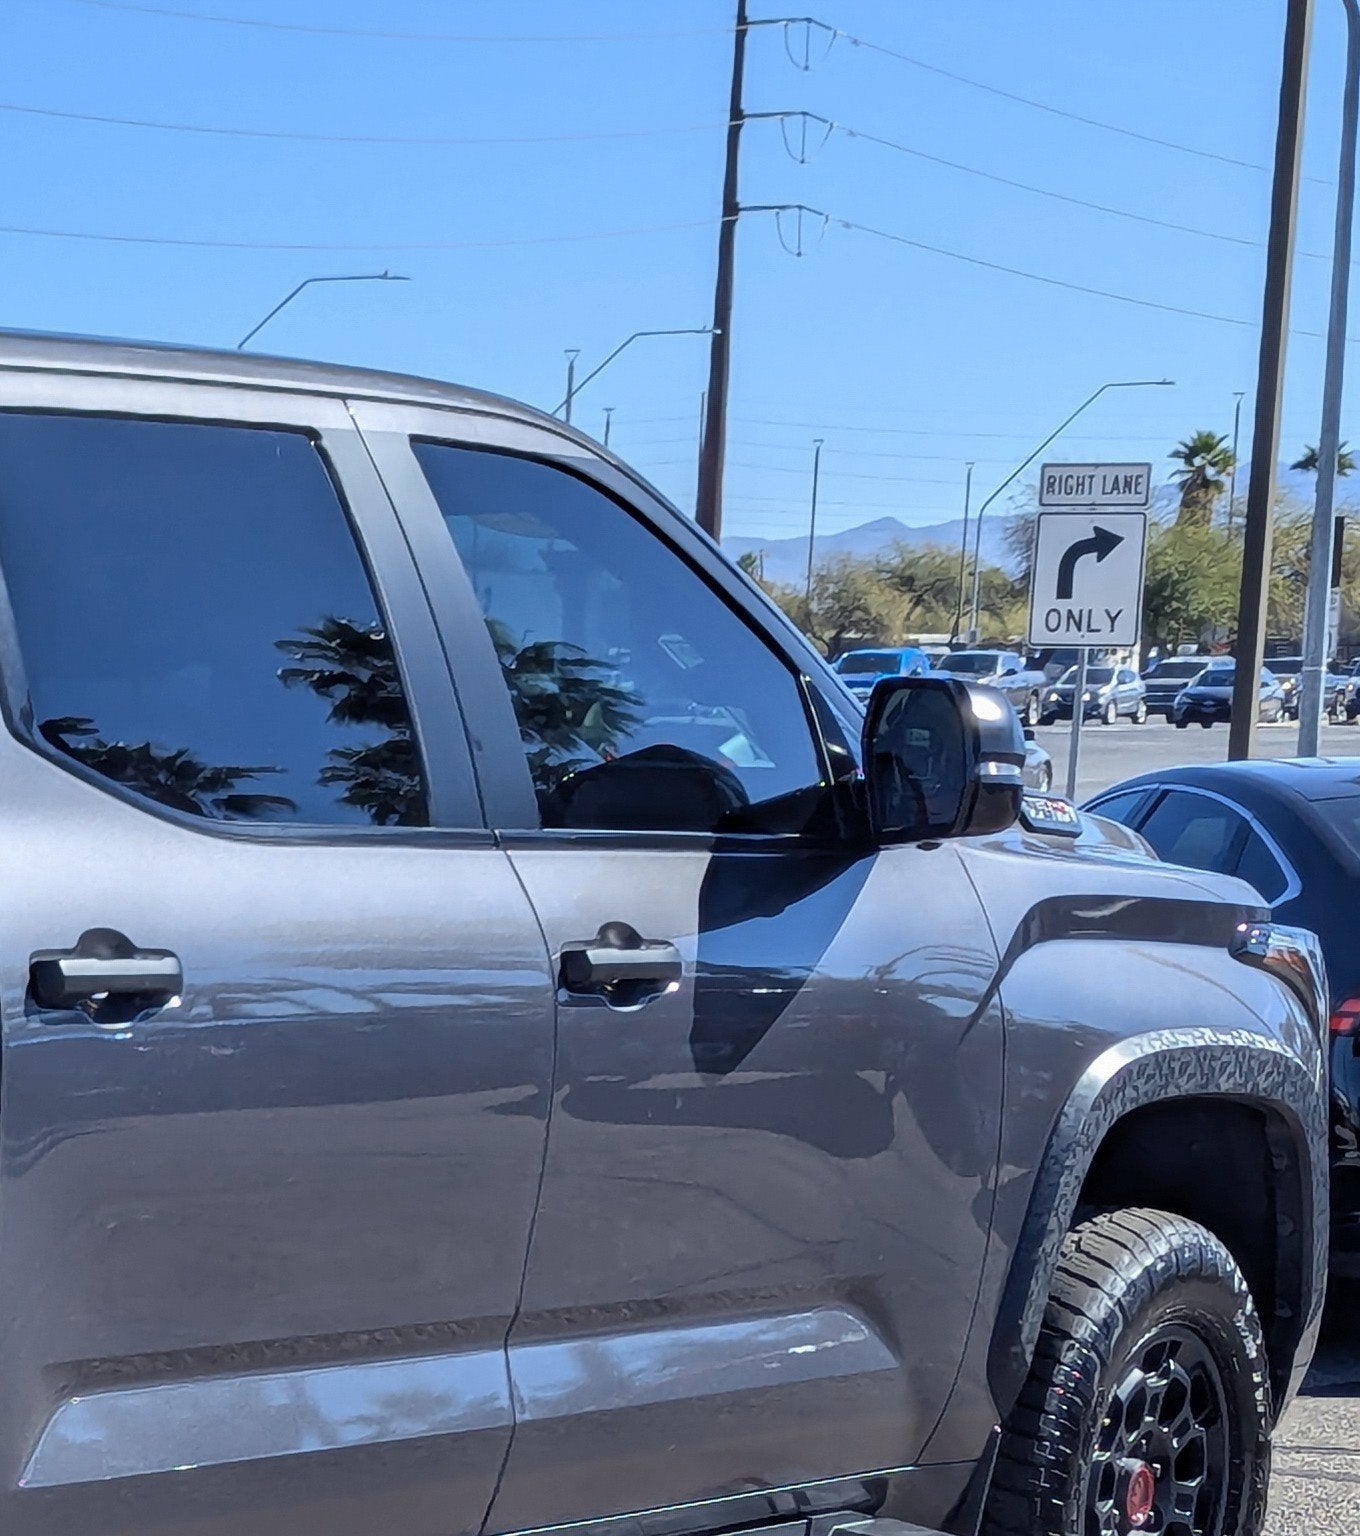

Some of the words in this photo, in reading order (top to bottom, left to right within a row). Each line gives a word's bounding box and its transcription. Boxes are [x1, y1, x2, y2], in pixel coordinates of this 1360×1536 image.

[1045, 473, 1096, 496] RIGHT
[1101, 473, 1144, 496] LANE
[1044, 607, 1124, 633] ONLY
